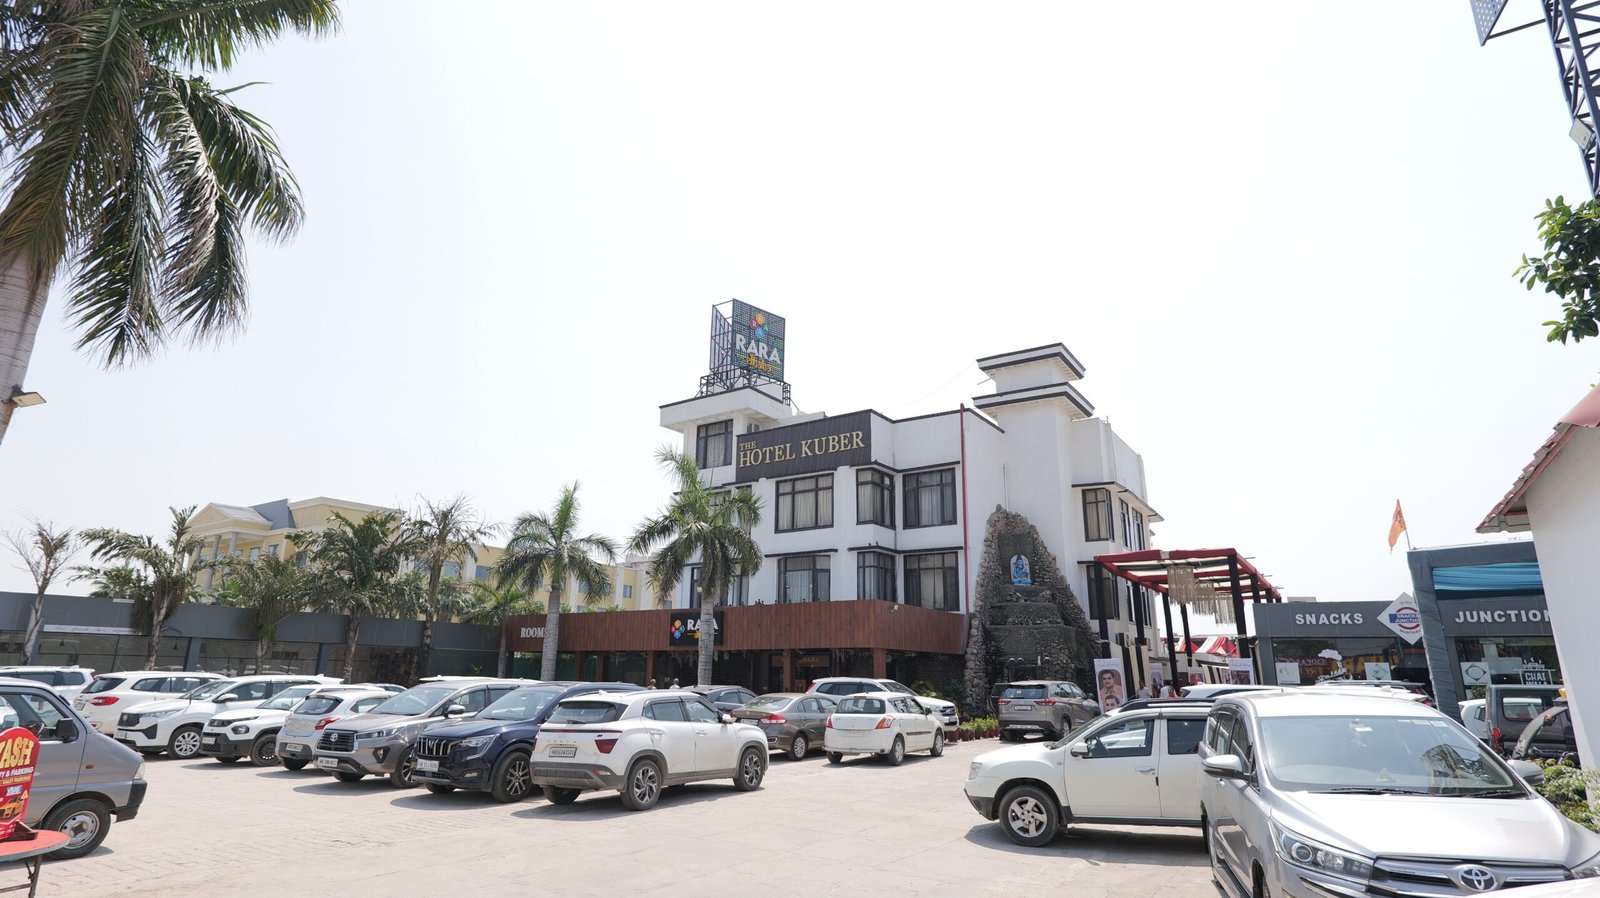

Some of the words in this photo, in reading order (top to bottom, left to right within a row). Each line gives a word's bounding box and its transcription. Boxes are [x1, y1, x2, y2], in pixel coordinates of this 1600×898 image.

[735, 333, 781, 365] RARA
[739, 443, 796, 467] HOTEL
[801, 431, 865, 457] KUBER
[740, 441, 757, 451] THE
[687, 618, 719, 631] RAA
[1295, 613, 1363, 624] SNACKS
[520, 626, 546, 638] ROOM
[1525, 672, 1547, 681] CHAI
[0, 736, 34, 768] ASH
[11, 766, 34, 776] PARKING
